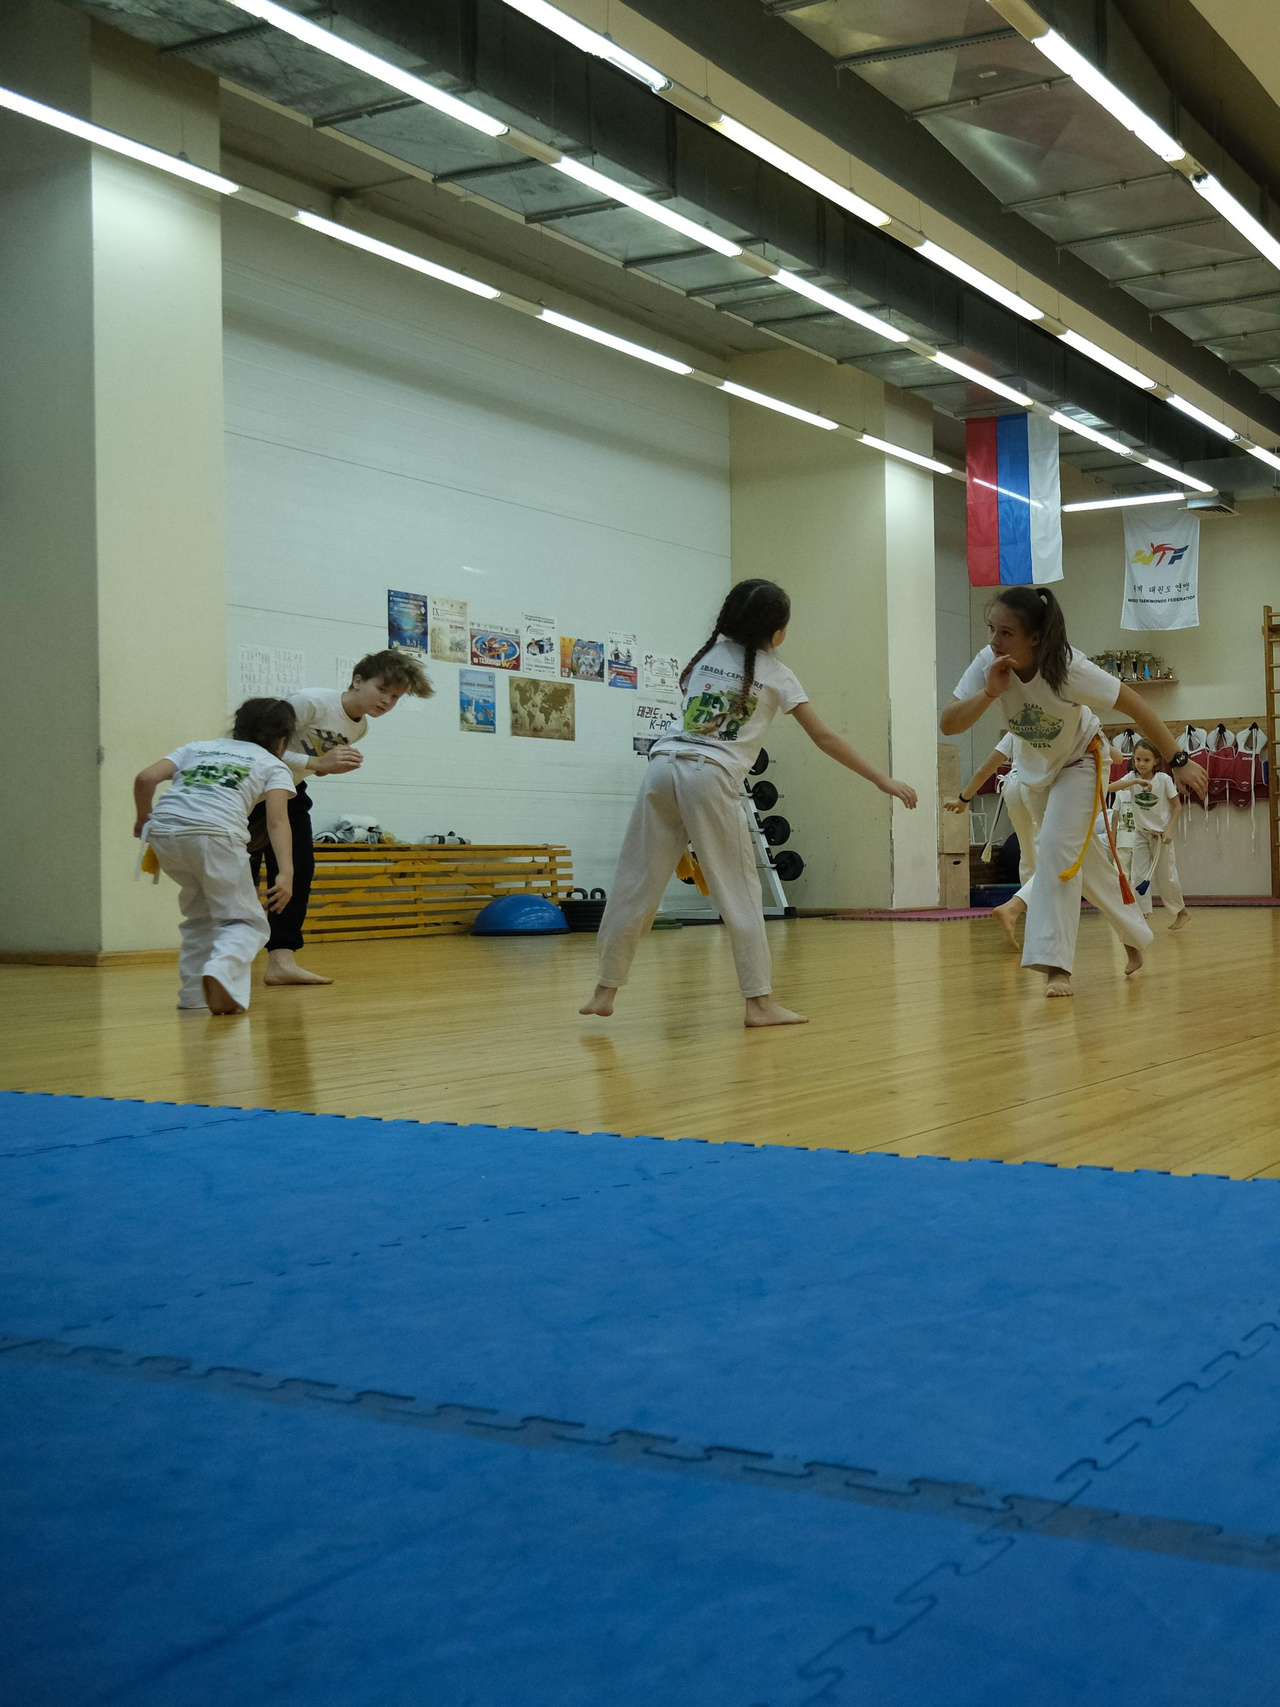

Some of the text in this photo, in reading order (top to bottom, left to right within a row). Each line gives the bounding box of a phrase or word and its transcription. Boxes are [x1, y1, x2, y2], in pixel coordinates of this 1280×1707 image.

[700, 664, 764, 690] ABADÁ-CAPORA
[637, 706, 660, 719] 태권도
[649, 720, 673, 731] K-PO
